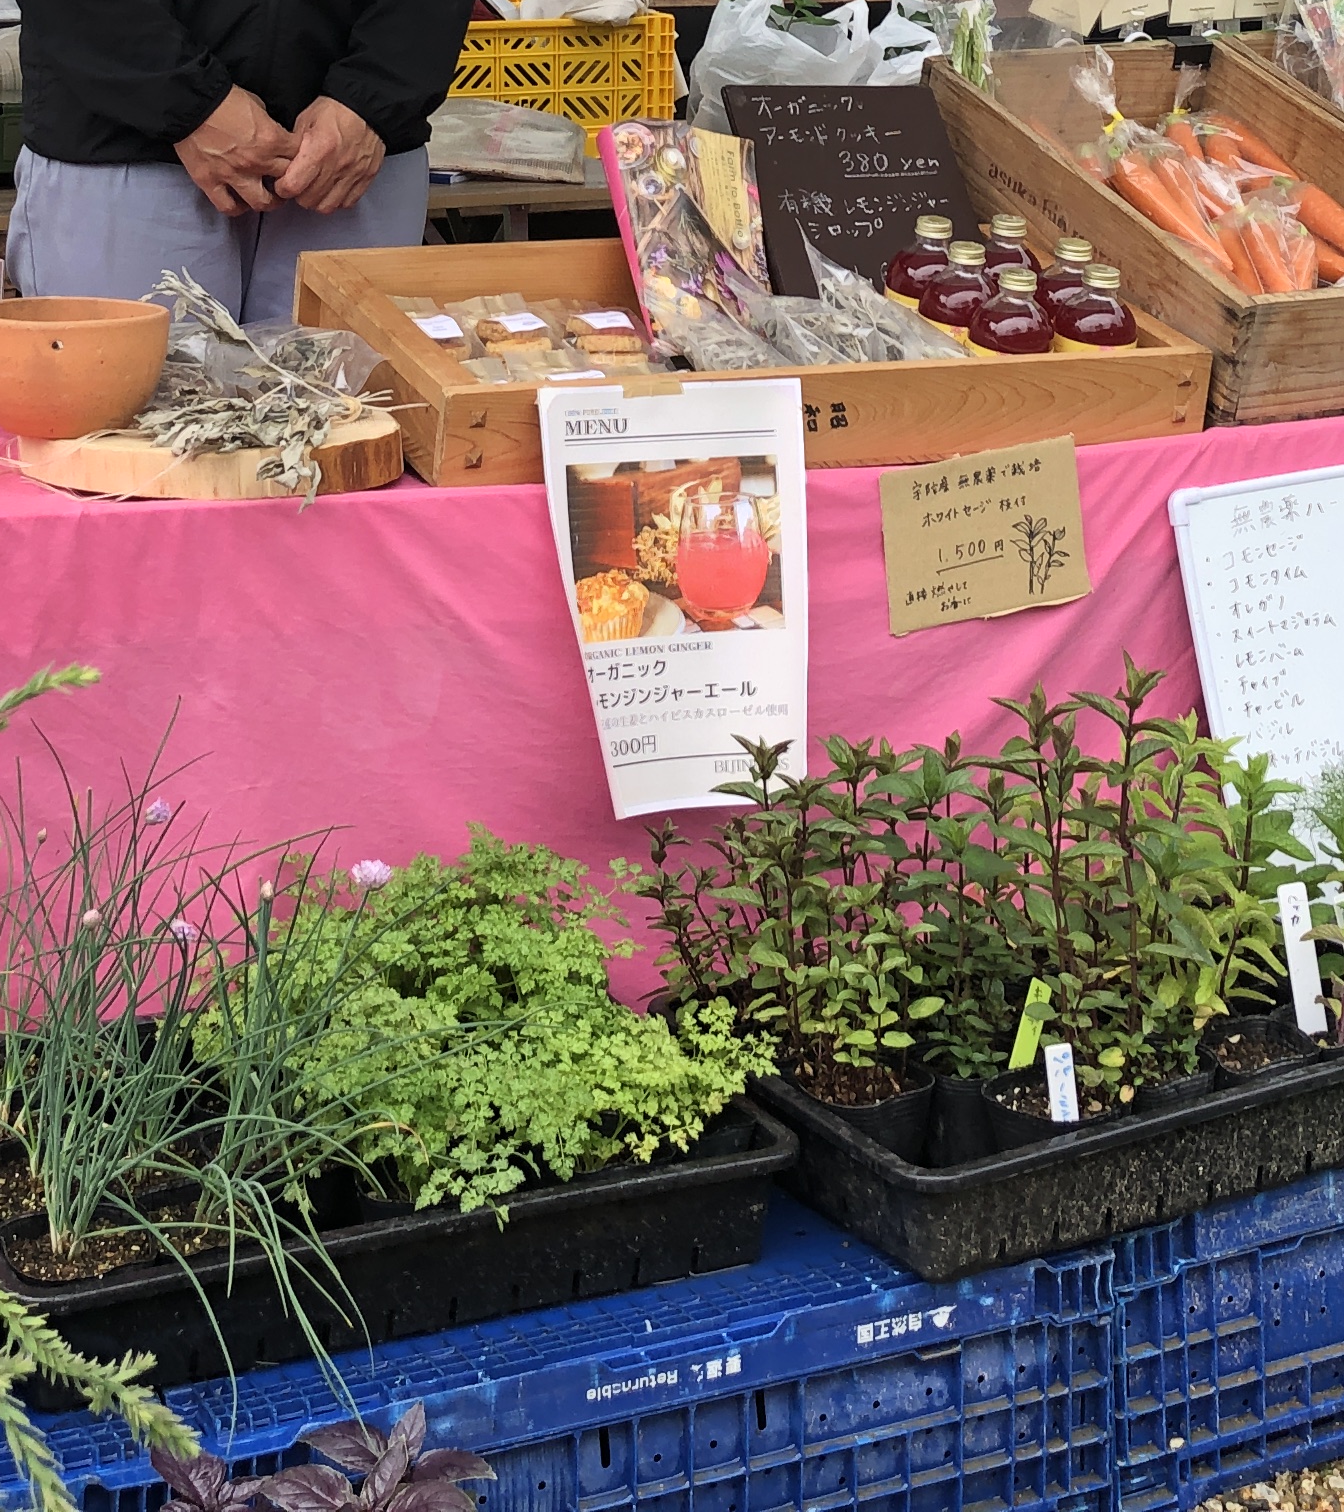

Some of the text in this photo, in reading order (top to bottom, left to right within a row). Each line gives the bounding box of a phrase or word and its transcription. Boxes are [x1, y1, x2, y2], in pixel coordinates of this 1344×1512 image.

[751, 94, 854, 119] オーガニック
[838, 150, 941, 172] 380 yen
[564, 417, 631, 436] MENU
[994, 538, 1005, 553] 円
[1222, 533, 1304, 571] コモンセージ
[1228, 565, 1309, 594] コモンタイム
[1228, 593, 1286, 620] オレガノ
[625, 645, 665, 657] LEMON
[668, 641, 713, 653] GINGER
[1234, 642, 1305, 669] レモンバーム
[596, 680, 759, 710] モンジンジャーエール
[1238, 668, 1287, 695] チャイブ
[1242, 689, 1306, 719] チャービル
[1246, 719, 1295, 745] バジル
[610, 734, 657, 758] 300円
[856, 1311, 923, 1345] 自然王国
[585, 1368, 679, 1402] Returnable
